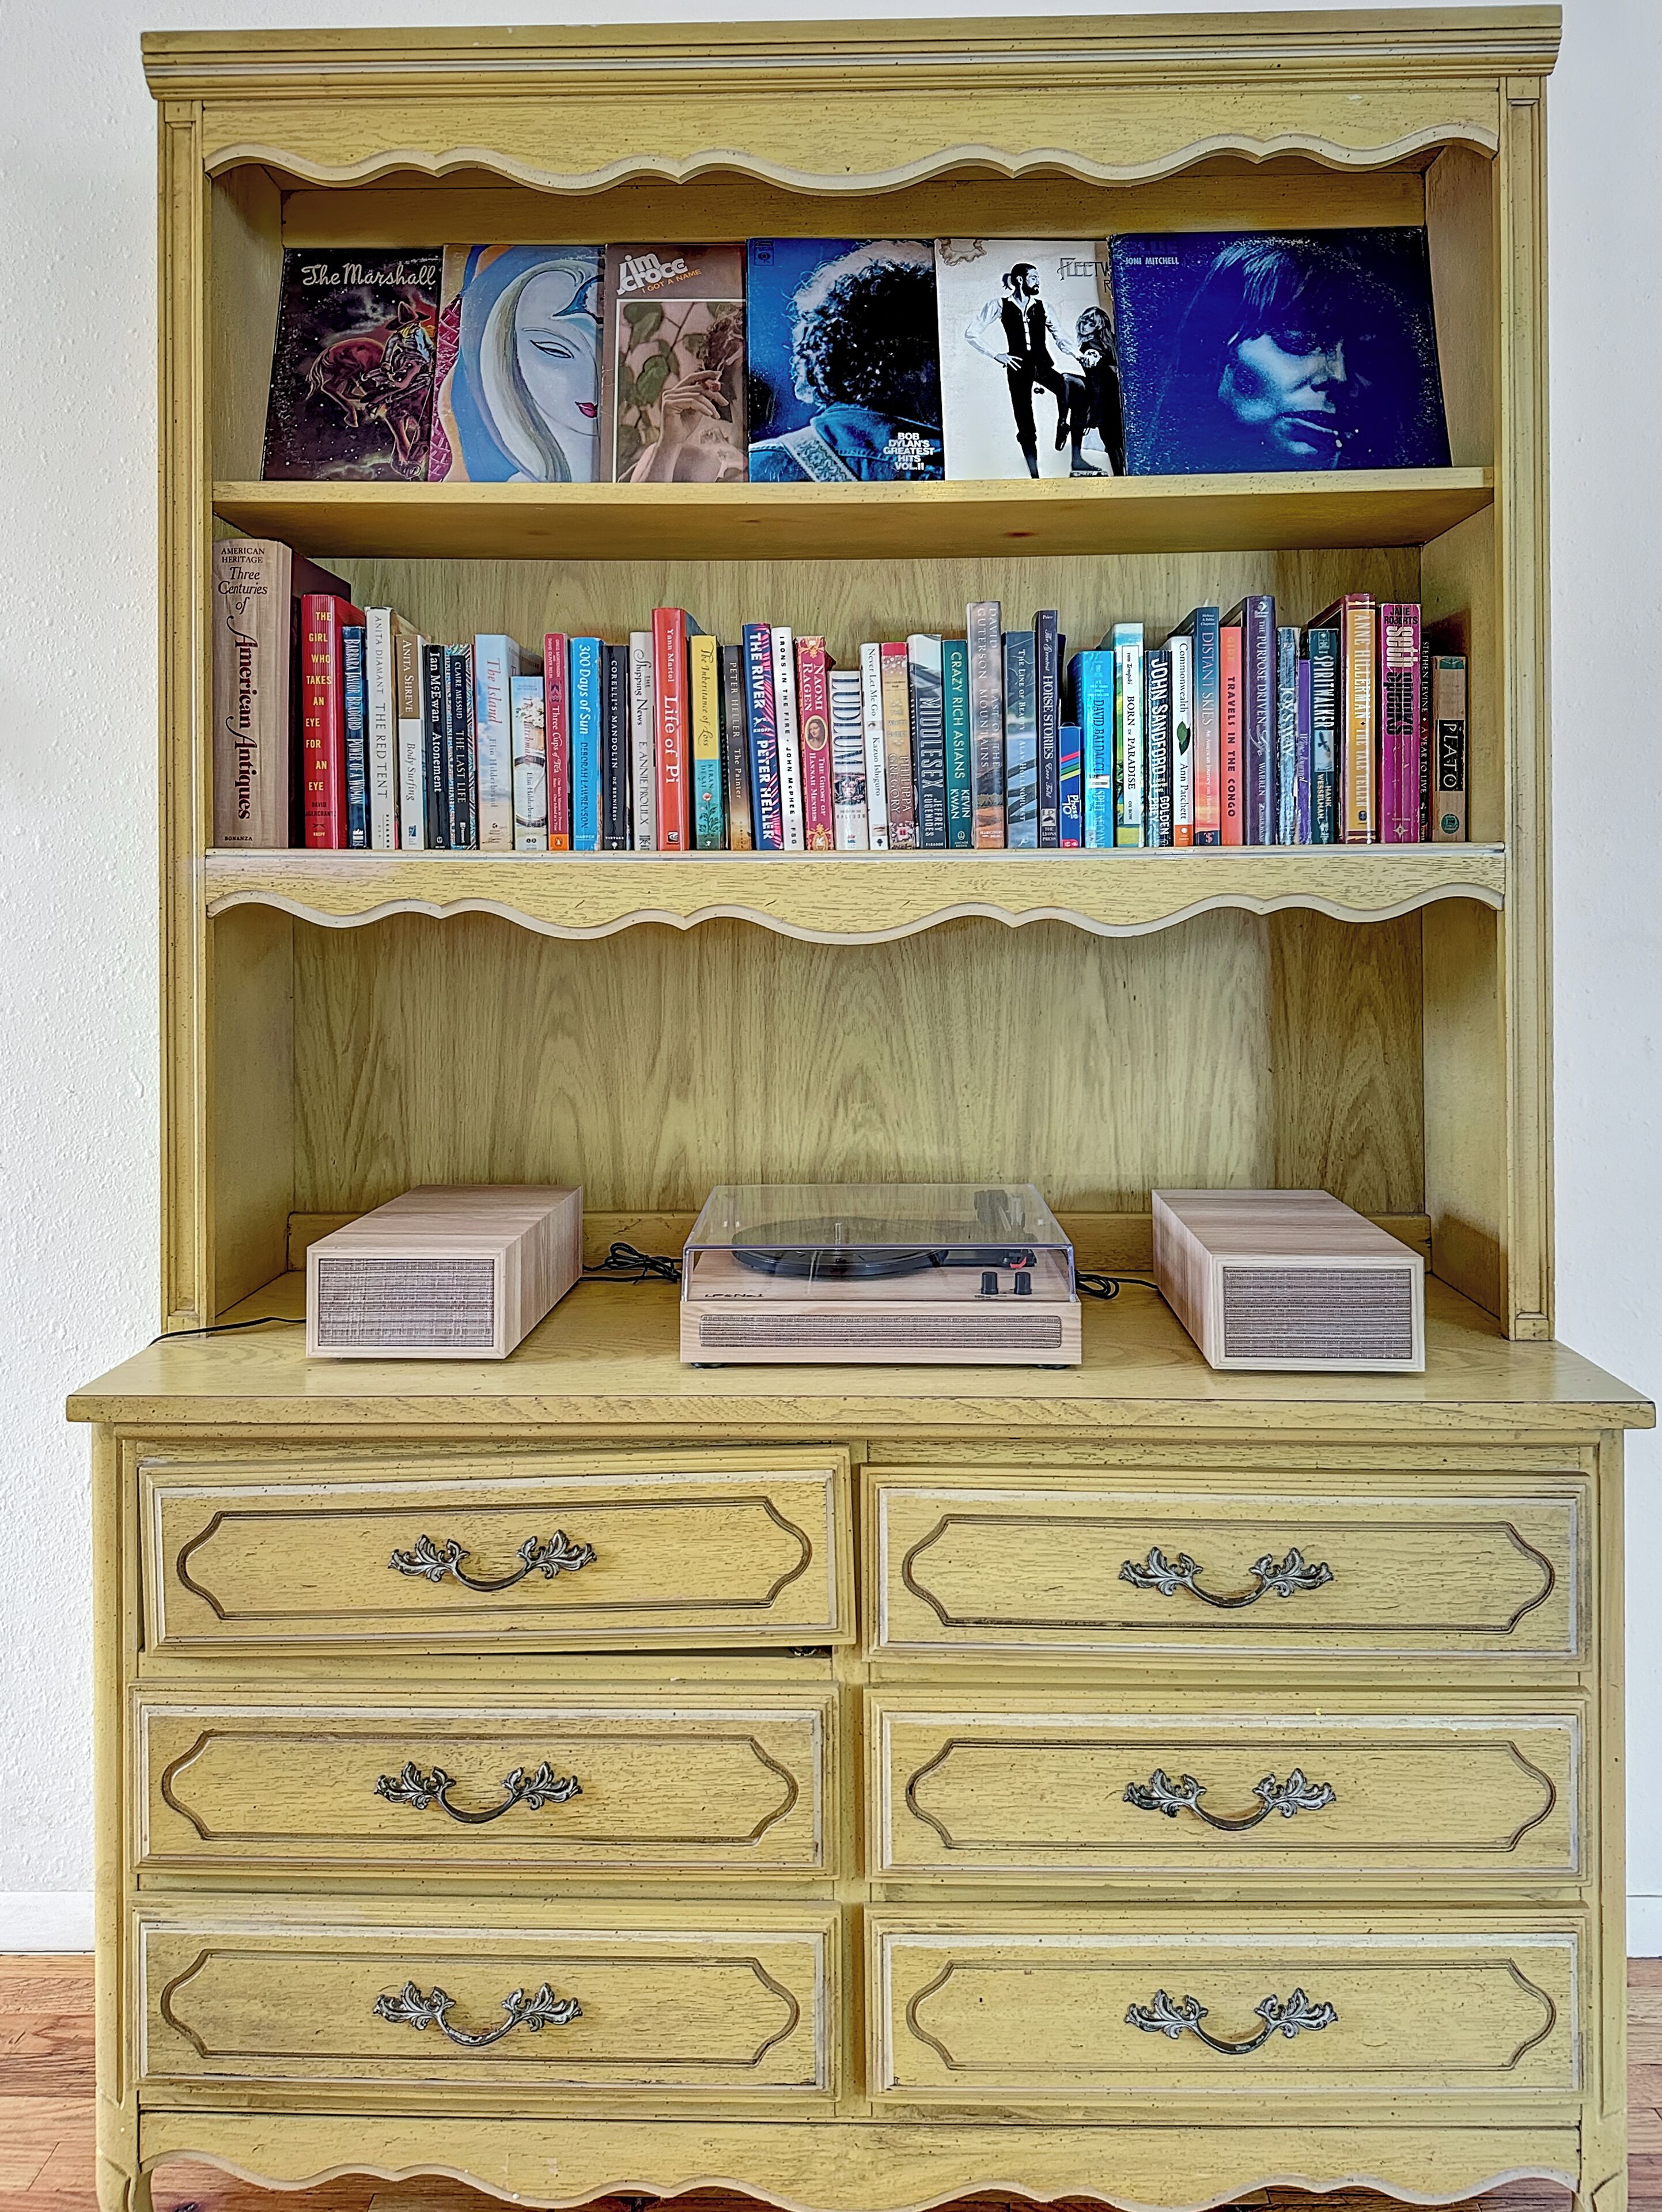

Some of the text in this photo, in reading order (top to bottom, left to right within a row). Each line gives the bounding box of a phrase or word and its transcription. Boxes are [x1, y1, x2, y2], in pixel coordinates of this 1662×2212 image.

[301, 263, 436, 286] The Marshall
[647, 282, 664, 291] GOT
[676, 269, 702, 282] NAME
[1125, 257, 1179, 265] JONI MITCHELL
[883, 446, 934, 455] GREATEST
[888, 440, 930, 448] DYLAN'S
[898, 432, 919, 440] BOB
[218, 581, 268, 594] Centuries
[230, 566, 260, 579] Three
[236, 597, 249, 615] of
[316, 612, 332, 621] THE
[1384, 616, 1418, 625] ROBERTS
[309, 633, 328, 642] GIRL
[311, 654, 330, 663] WHO
[977, 608, 998, 679] DAVID GUTERSON
[1386, 626, 1418, 668] seth
[306, 676, 332, 684] TAKES
[375, 650, 384, 694] DIAMANT
[403, 639, 415, 713] ANITA SHREVE
[749, 632, 766, 710] THE RIVER
[782, 673, 787, 683] IN
[868, 648, 876, 672] Never
[1151, 658, 1168, 701] JOHN
[1179, 643, 1188, 713] Commonwealth
[1202, 632, 1214, 686] DISTANT
[1257, 636, 1267, 724] PURPOSE DRIVEN
[1354, 614, 1371, 719] ANNE HILLERMAN
[313, 696, 324, 705] AN
[430, 652, 442, 722] Ian McEwan
[487, 658, 502, 724] The Island
[578, 645, 591, 734] 300 Days of Sun
[701, 665, 711, 713] Inheritance
[729, 662, 740, 737] PETER HELLER
[803, 662, 813, 711] RAGEN
[813, 664, 824, 710] NAOMI
[870, 691, 877, 703] Me
[1313, 656, 1335, 728] SPIRITWALKER
[225, 616, 258, 819] American Antiques
[305, 718, 320, 726] EYE
[637, 699, 648, 726] News
[831, 678, 863, 764] LUDLUM
[870, 705, 879, 716] Go
[951, 652, 966, 779] CRAZY RICH ASIANS
[1043, 675, 1054, 760] HORSE STORIES
[1093, 699, 1104, 725] DAVID
[1202, 692, 1214, 725] SKIES
[306, 740, 321, 748] FOR
[376, 703, 388, 798] THE RED TENT
[551, 732, 562, 751] Cups
[664, 695, 680, 783] Life of Pi
[919, 697, 944, 789] MIDDLESEX
[1093, 728, 1104, 773] BALDACCI
[1127, 695, 1135, 790] BORN PARADISE
[1151, 704, 1168, 774] SANDFORD
[1227, 676, 1236, 817] TRAVELS IN THE CONGO
[1443, 724, 1458, 787] PLATO
[316, 761, 327, 770] AN
[405, 743, 417, 801] Body Surfing
[432, 732, 442, 793] Atonement
[456, 730, 466, 803] THE LAST LIFE
[872, 737, 881, 796] Kazuo Ishiguro
[888, 754, 902, 813] GREGORY
[899, 755, 911, 812] PHILIPPA
[1420, 760, 1428, 772] TO
[309, 782, 324, 791] EYE
[756, 740, 775, 840] PETER HELLER
[951, 789, 960, 819] KWAN
[961, 789, 970, 818] KEVIN
[1070, 795, 1081, 820] Phase
[1180, 763, 1189, 819] Ann Patchett
[924, 794, 934, 836] EUGENIDES
[933, 798, 943, 831] JEFFREY
[1062, 802, 1072, 815] 10
[1149, 795, 1159, 822] PREY
[1160, 796, 1170, 835] GOLDEN
